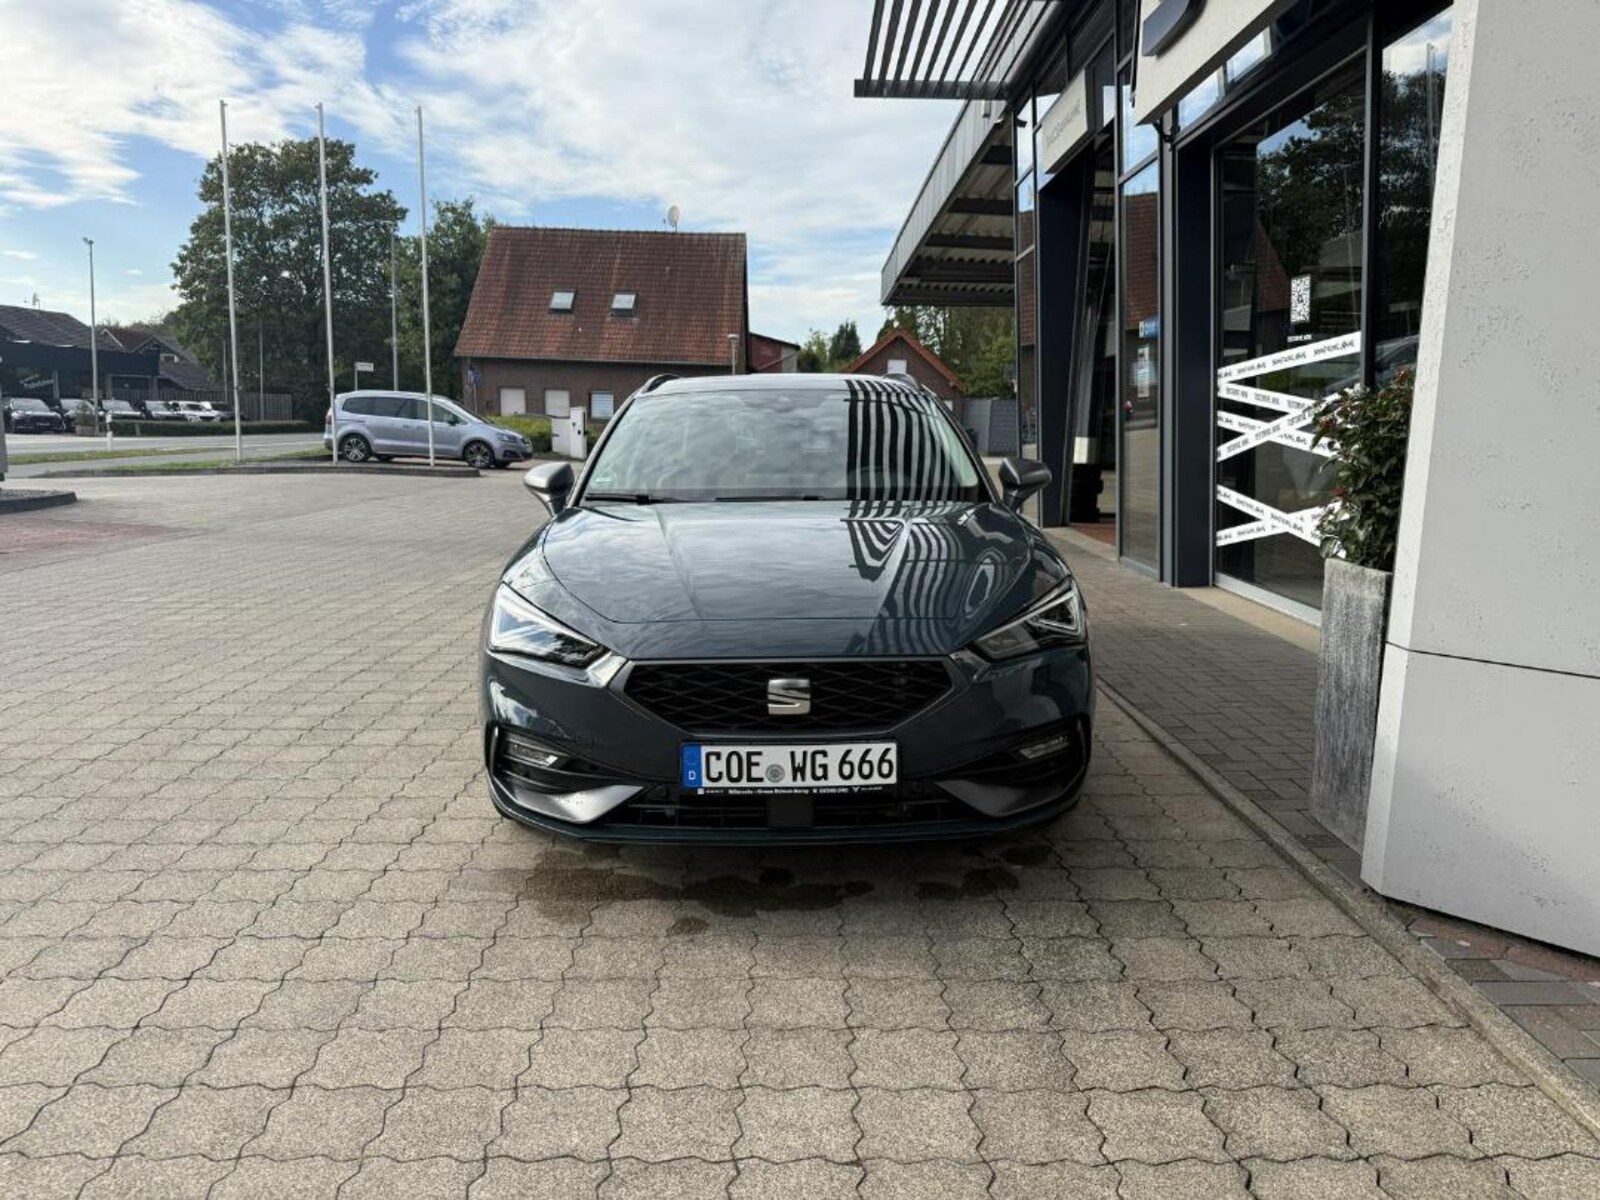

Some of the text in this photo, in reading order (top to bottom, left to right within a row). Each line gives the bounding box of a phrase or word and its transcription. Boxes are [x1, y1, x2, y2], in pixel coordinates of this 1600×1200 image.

[688, 769, 697, 780] D
[705, 748, 894, 783] COE WG 666
